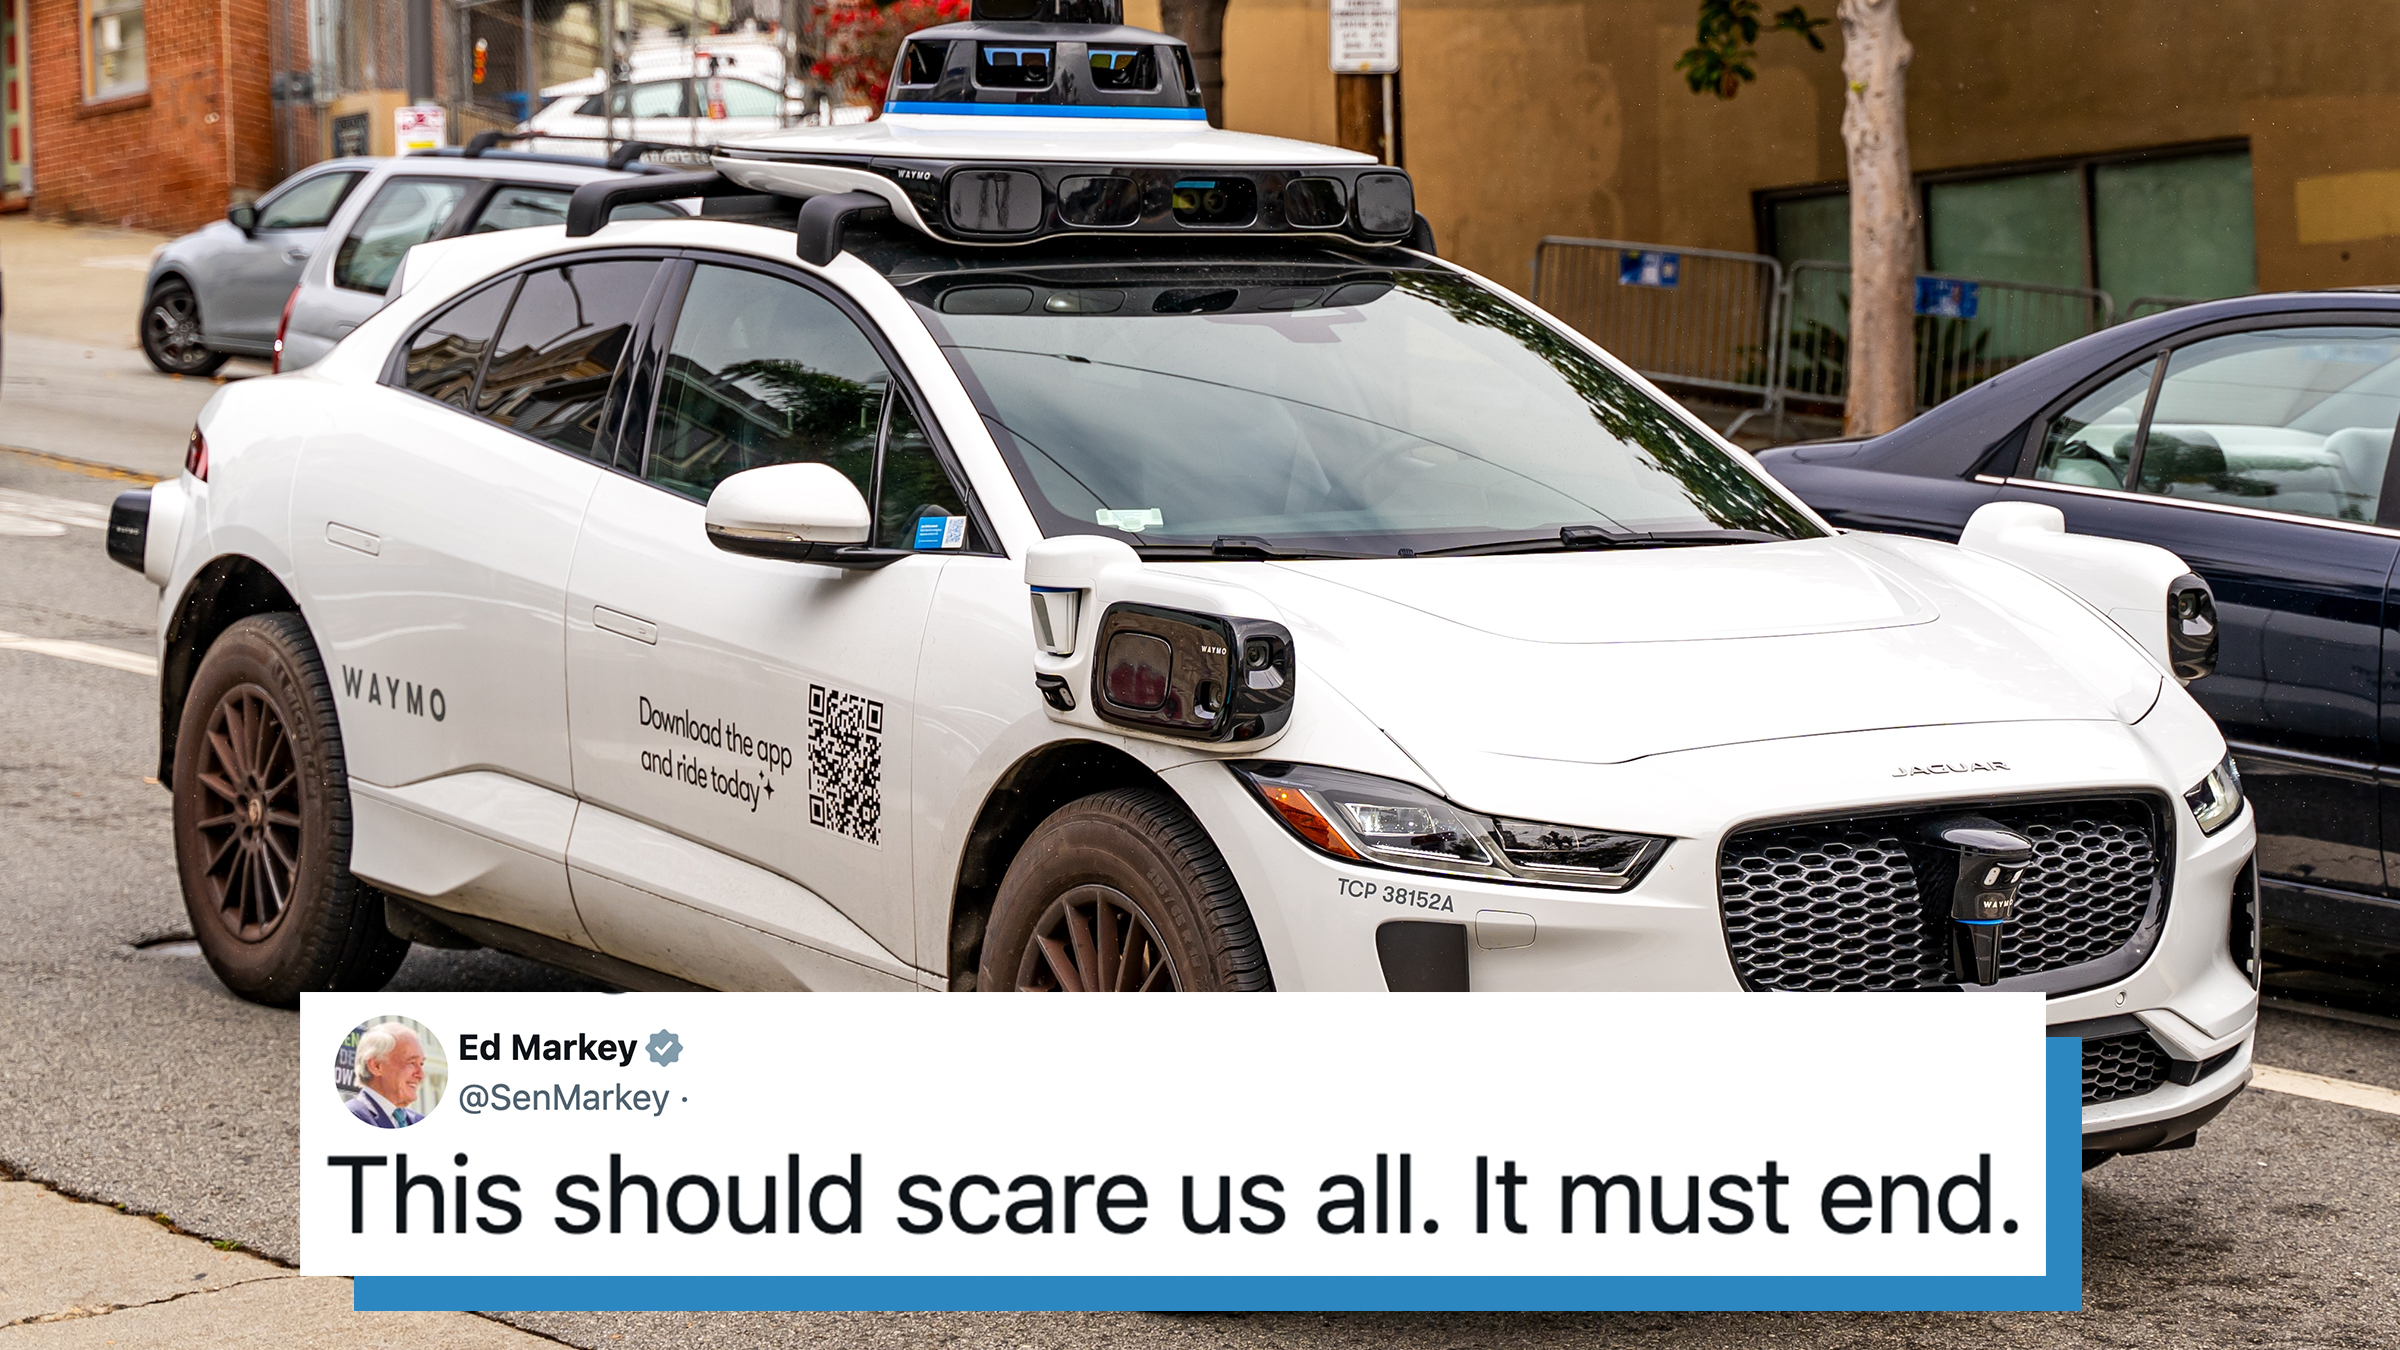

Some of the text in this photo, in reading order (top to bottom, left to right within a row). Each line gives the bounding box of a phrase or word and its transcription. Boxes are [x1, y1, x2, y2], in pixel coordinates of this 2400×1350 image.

[898, 170, 931, 181] WAYMO
[1201, 645, 1227, 656] WAYMO
[342, 664, 446, 722] WAYMO
[639, 695, 792, 776] Download the app
[641, 749, 760, 813] and ride today
[1892, 761, 2011, 777] JAGUAR
[1338, 877, 1454, 913] TCP 38152A
[1983, 899, 2014, 908] WAYMO
